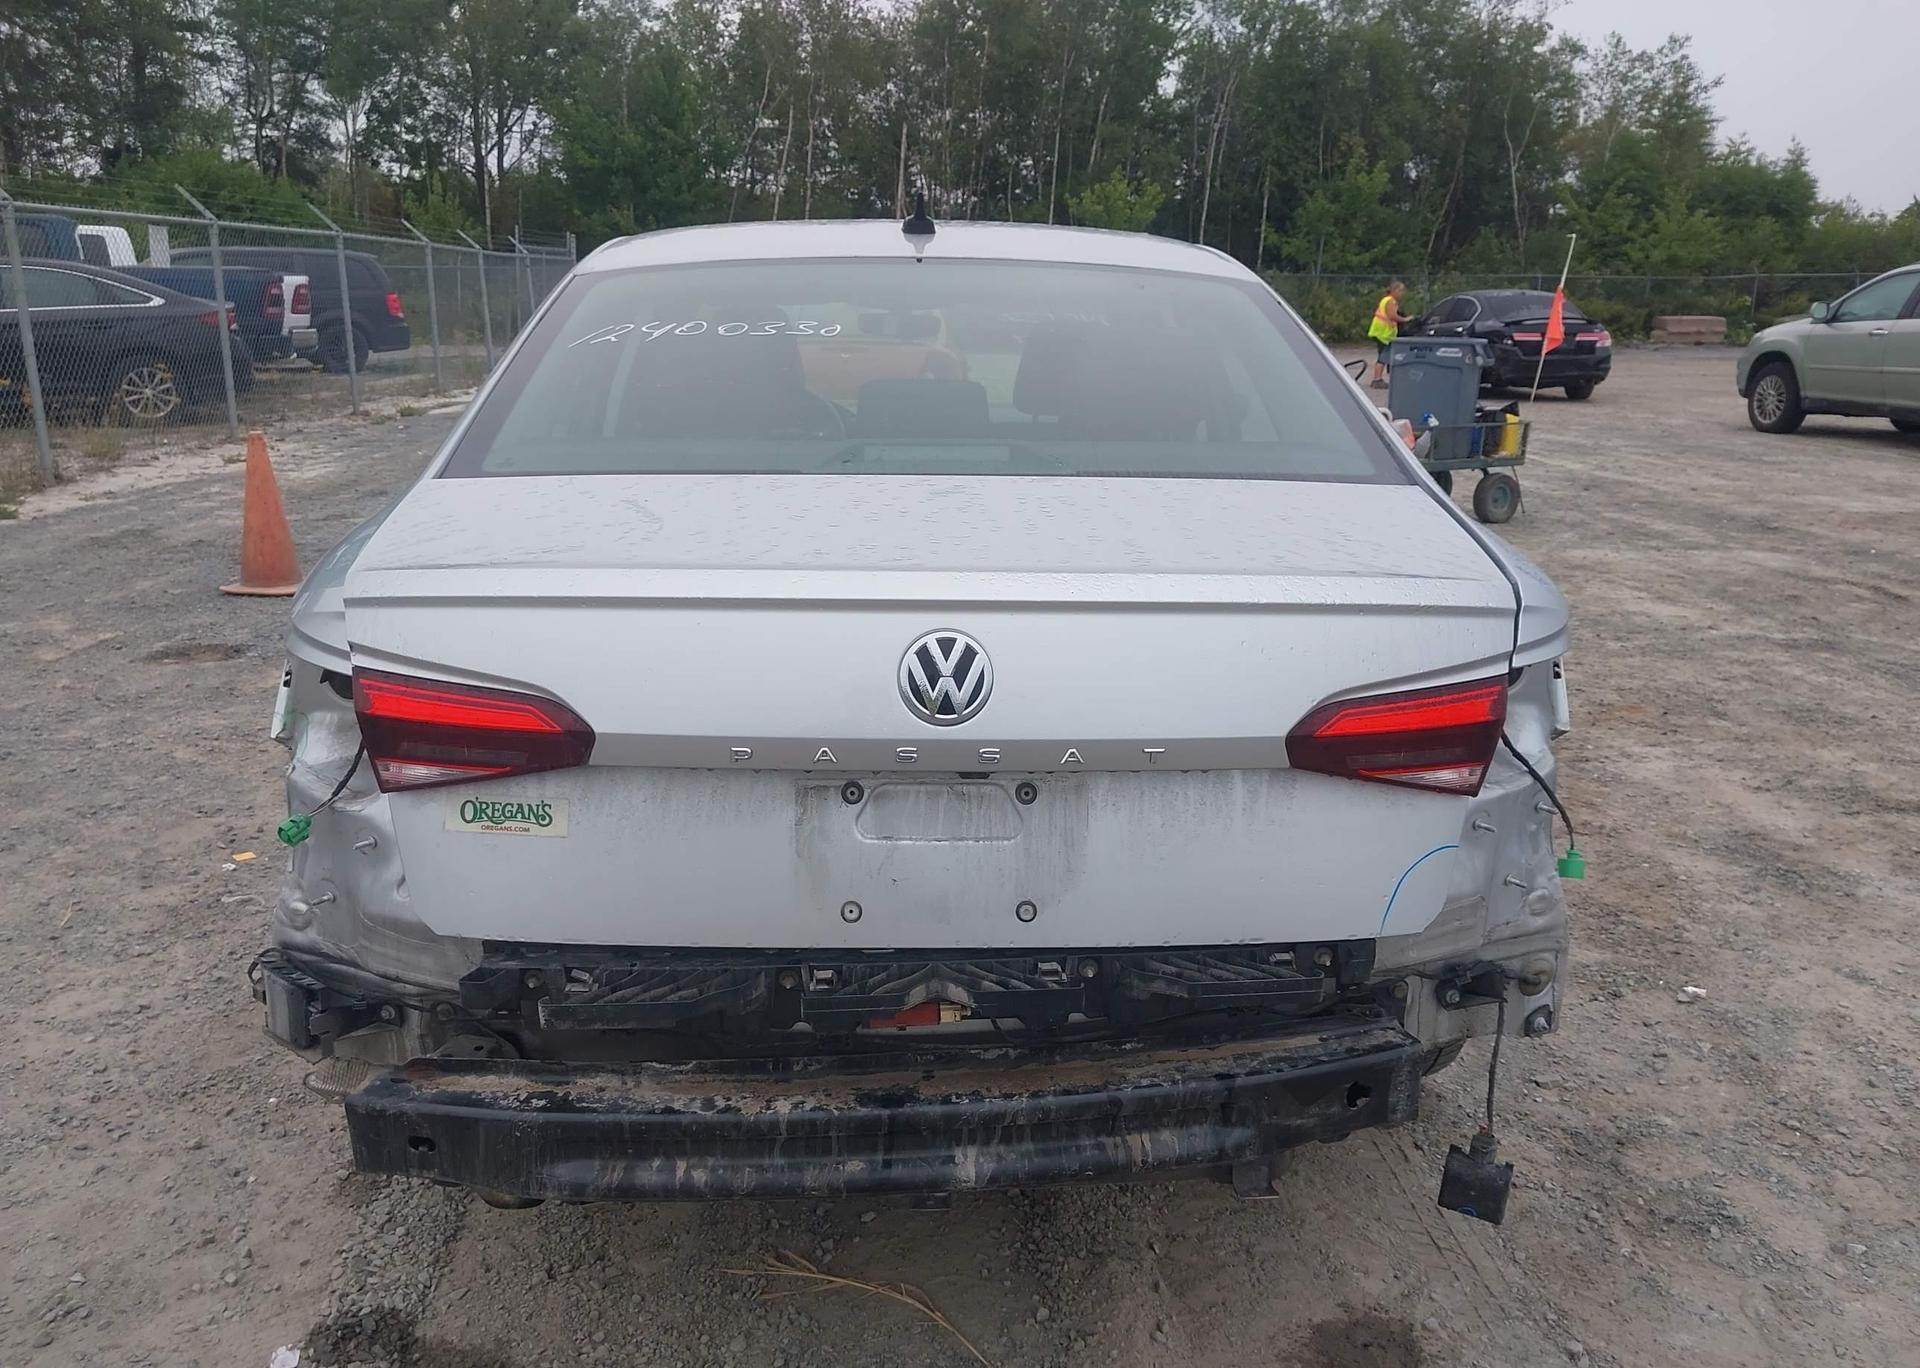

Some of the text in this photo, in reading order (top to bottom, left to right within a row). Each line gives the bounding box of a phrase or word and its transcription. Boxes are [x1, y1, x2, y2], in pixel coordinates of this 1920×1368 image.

[906, 635, 987, 717] VW
[730, 746, 1167, 765] PASSAT
[481, 824, 531, 833] OREGANS.COM
